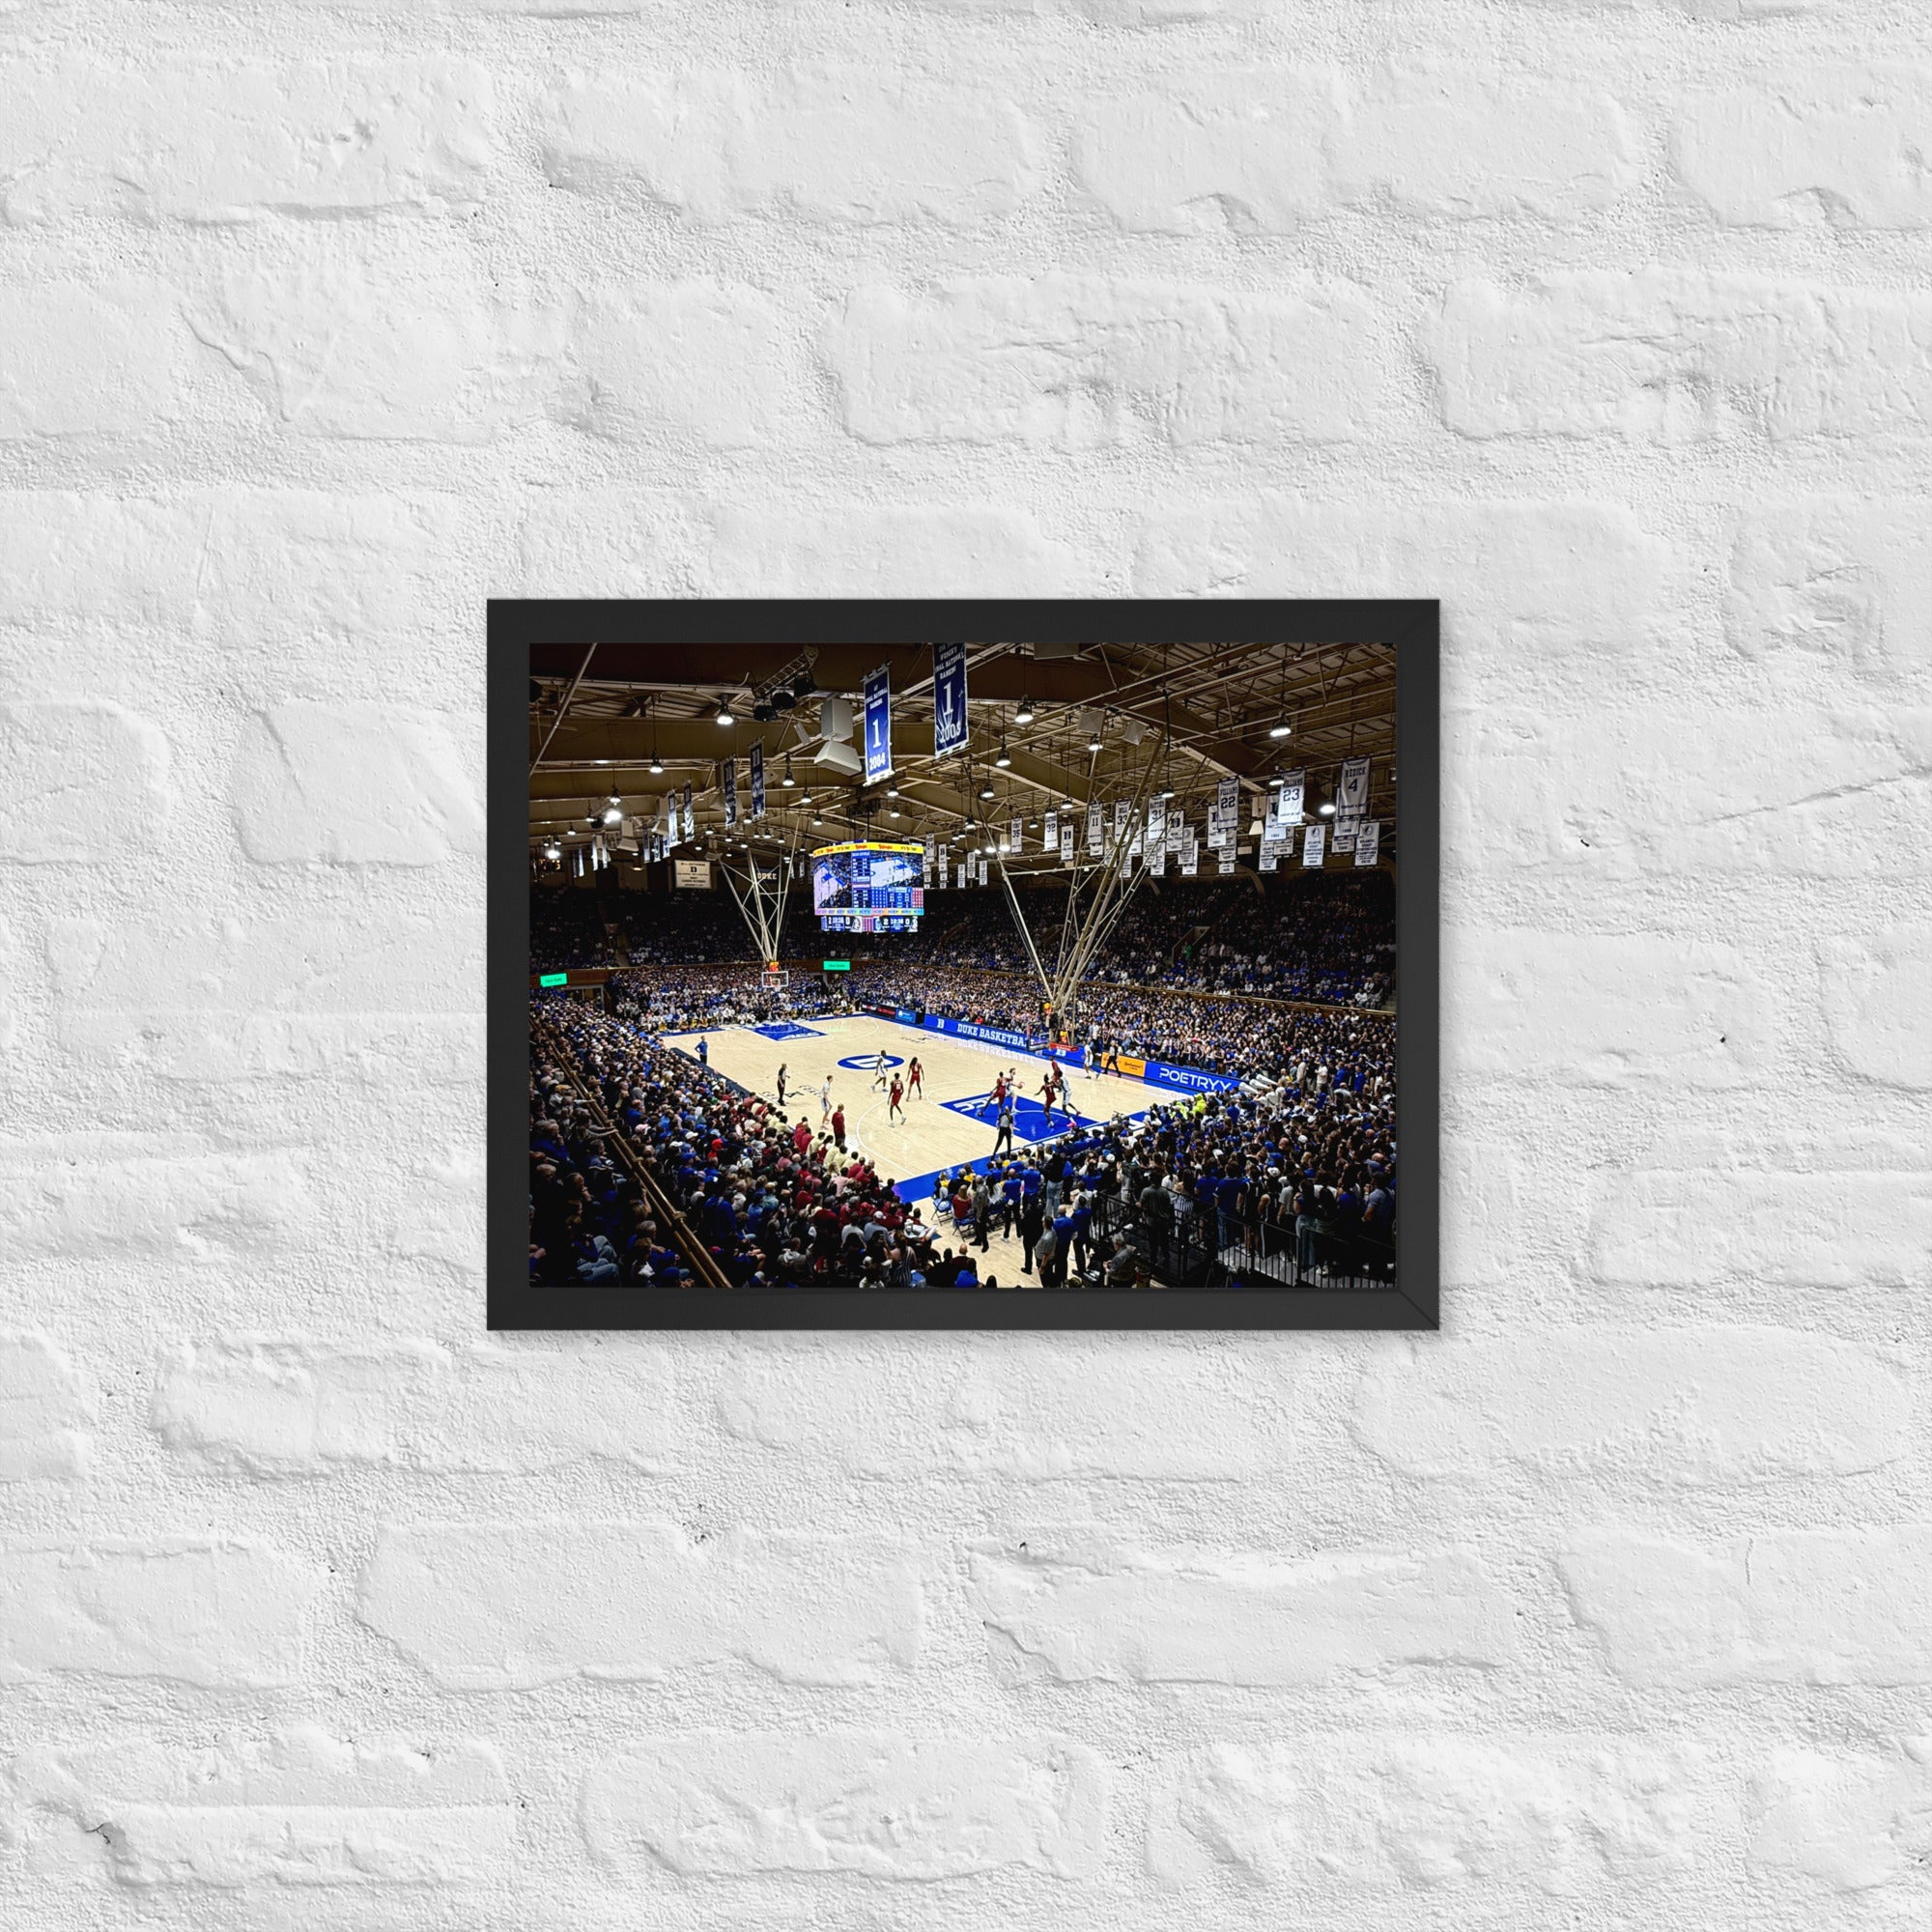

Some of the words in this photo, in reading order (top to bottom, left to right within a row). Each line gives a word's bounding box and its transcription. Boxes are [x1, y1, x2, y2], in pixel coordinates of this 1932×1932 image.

[943, 681, 953, 716] 1
[872, 719, 881, 749] 1
[869, 752, 886, 771] 2004
[1348, 779, 1358, 792] 4
[1283, 788, 1300, 802] 23
[1220, 796, 1236, 810] 22
[1092, 817, 1099, 827] 11
[1151, 810, 1163, 820] 31
[1012, 830, 1020, 838] 35
[1046, 823, 1056, 833] 32
[956, 1023, 979, 1037] DUKE
